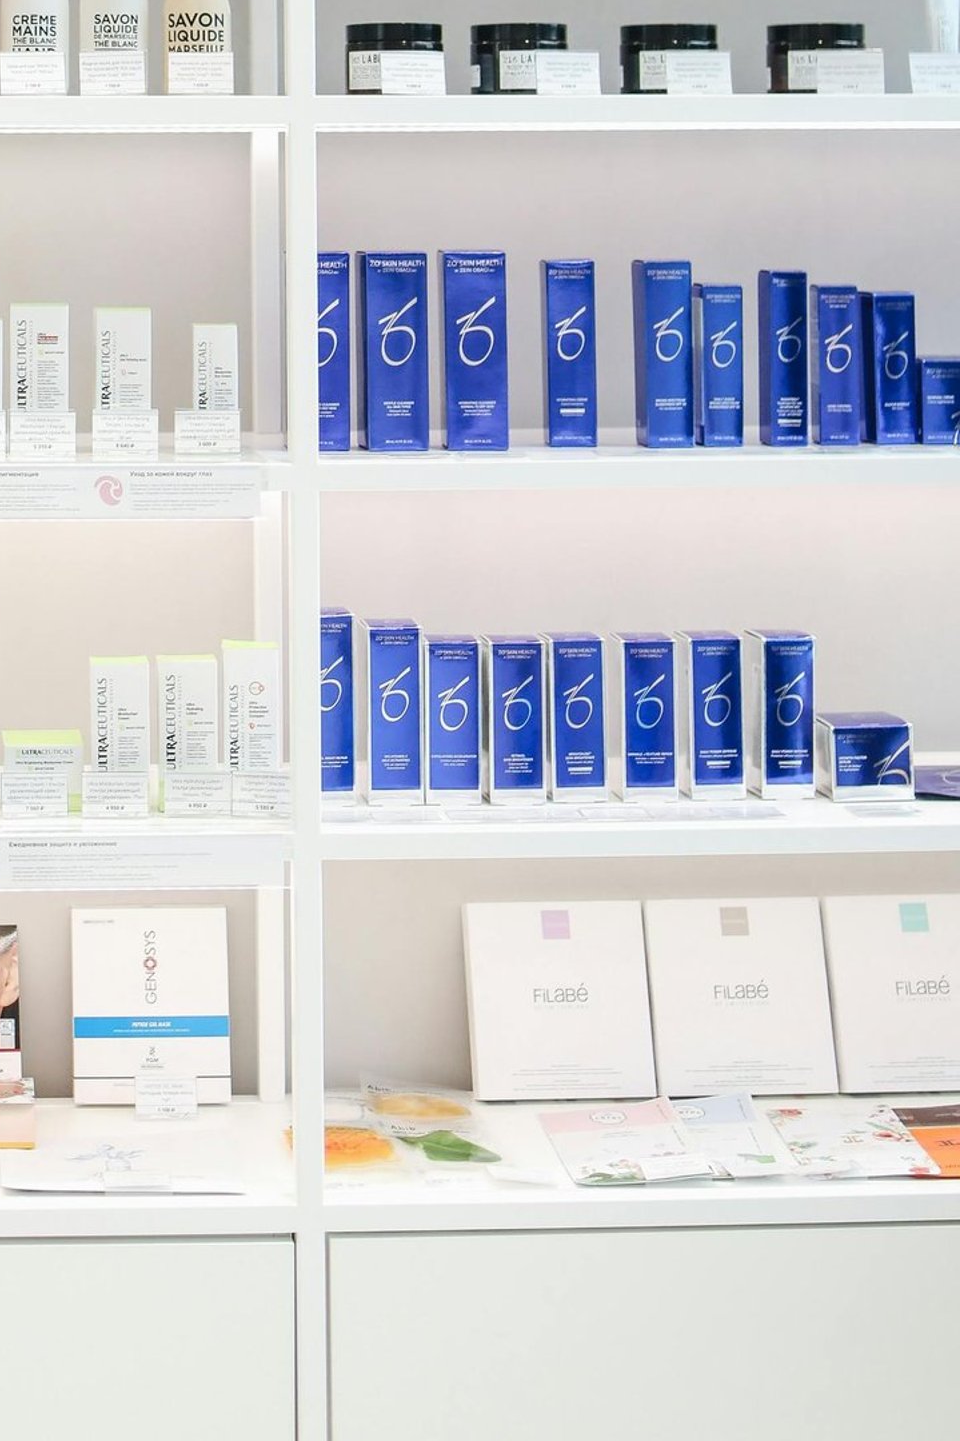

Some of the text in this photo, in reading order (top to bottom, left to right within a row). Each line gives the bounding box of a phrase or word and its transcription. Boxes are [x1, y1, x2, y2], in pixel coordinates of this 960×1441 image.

[93, 13, 139, 25] SAVON
[168, 12, 225, 28] SAVON
[12, 26, 57, 37] MAINS
[93, 25, 138, 35] LIQUIDE
[168, 29, 225, 43] LIQUIDE
[198, 342, 207, 410] TRACEUTICALS
[144, 929, 157, 1004] GENOSYS
